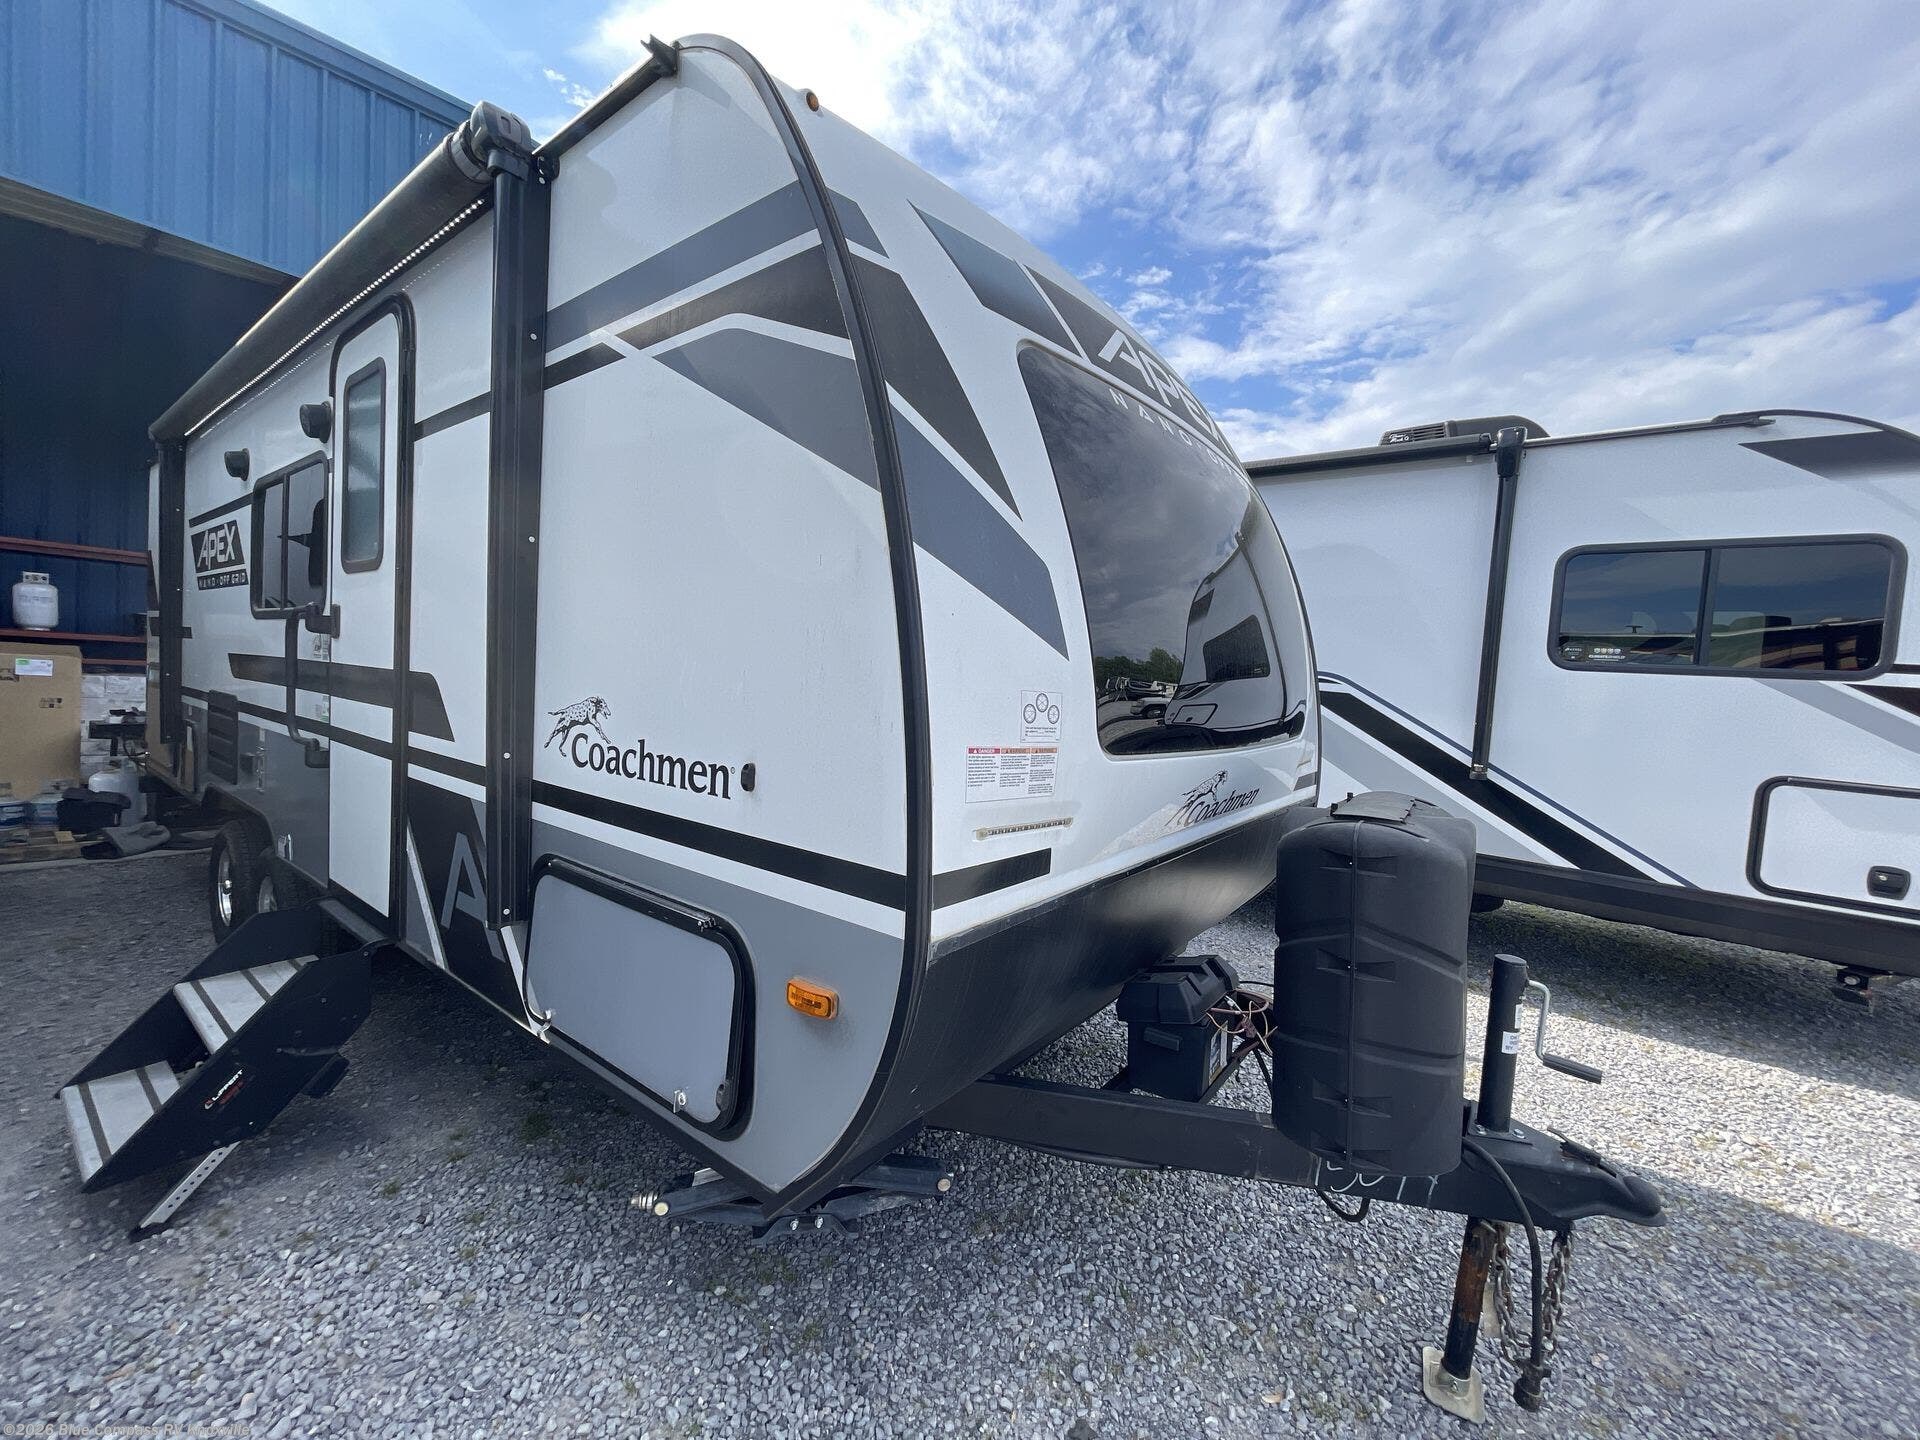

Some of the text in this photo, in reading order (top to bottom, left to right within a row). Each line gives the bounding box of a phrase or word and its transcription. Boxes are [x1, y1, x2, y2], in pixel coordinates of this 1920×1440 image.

[1109, 388, 1193, 446] NANO
[197, 523, 236, 570] APEX
[571, 732, 731, 800] Coachmen
[1183, 788, 1260, 828] Coachmen
